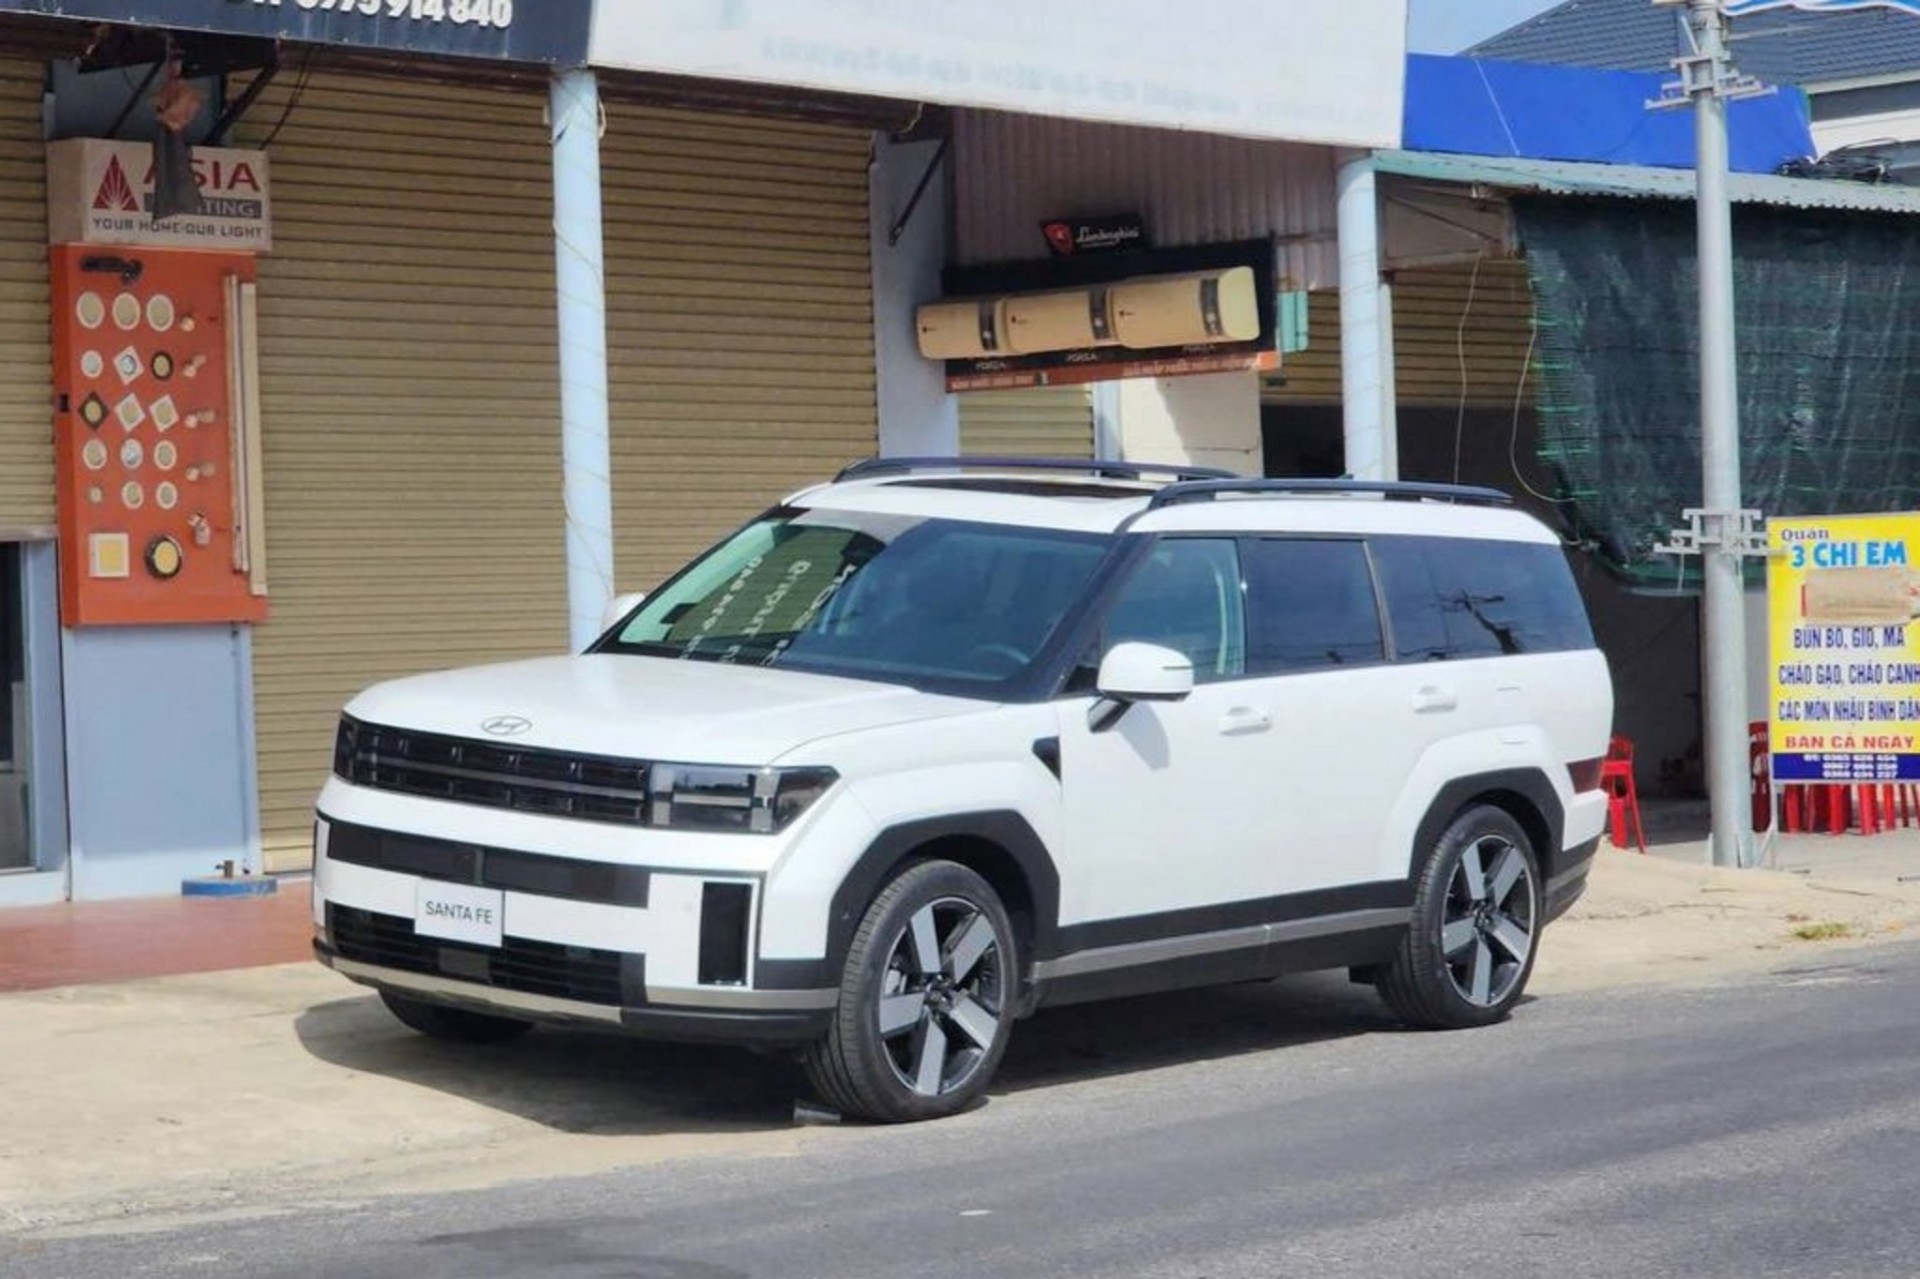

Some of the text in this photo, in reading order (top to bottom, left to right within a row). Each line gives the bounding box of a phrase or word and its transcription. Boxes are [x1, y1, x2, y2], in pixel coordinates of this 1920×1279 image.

[143, 159, 261, 191] SIA
[93, 217, 134, 231] YOUR
[220, 225, 262, 237] LIGHT
[1792, 544, 1806, 568] 3
[1866, 541, 1906, 566] EM
[425, 900, 494, 925] SANTA FE
